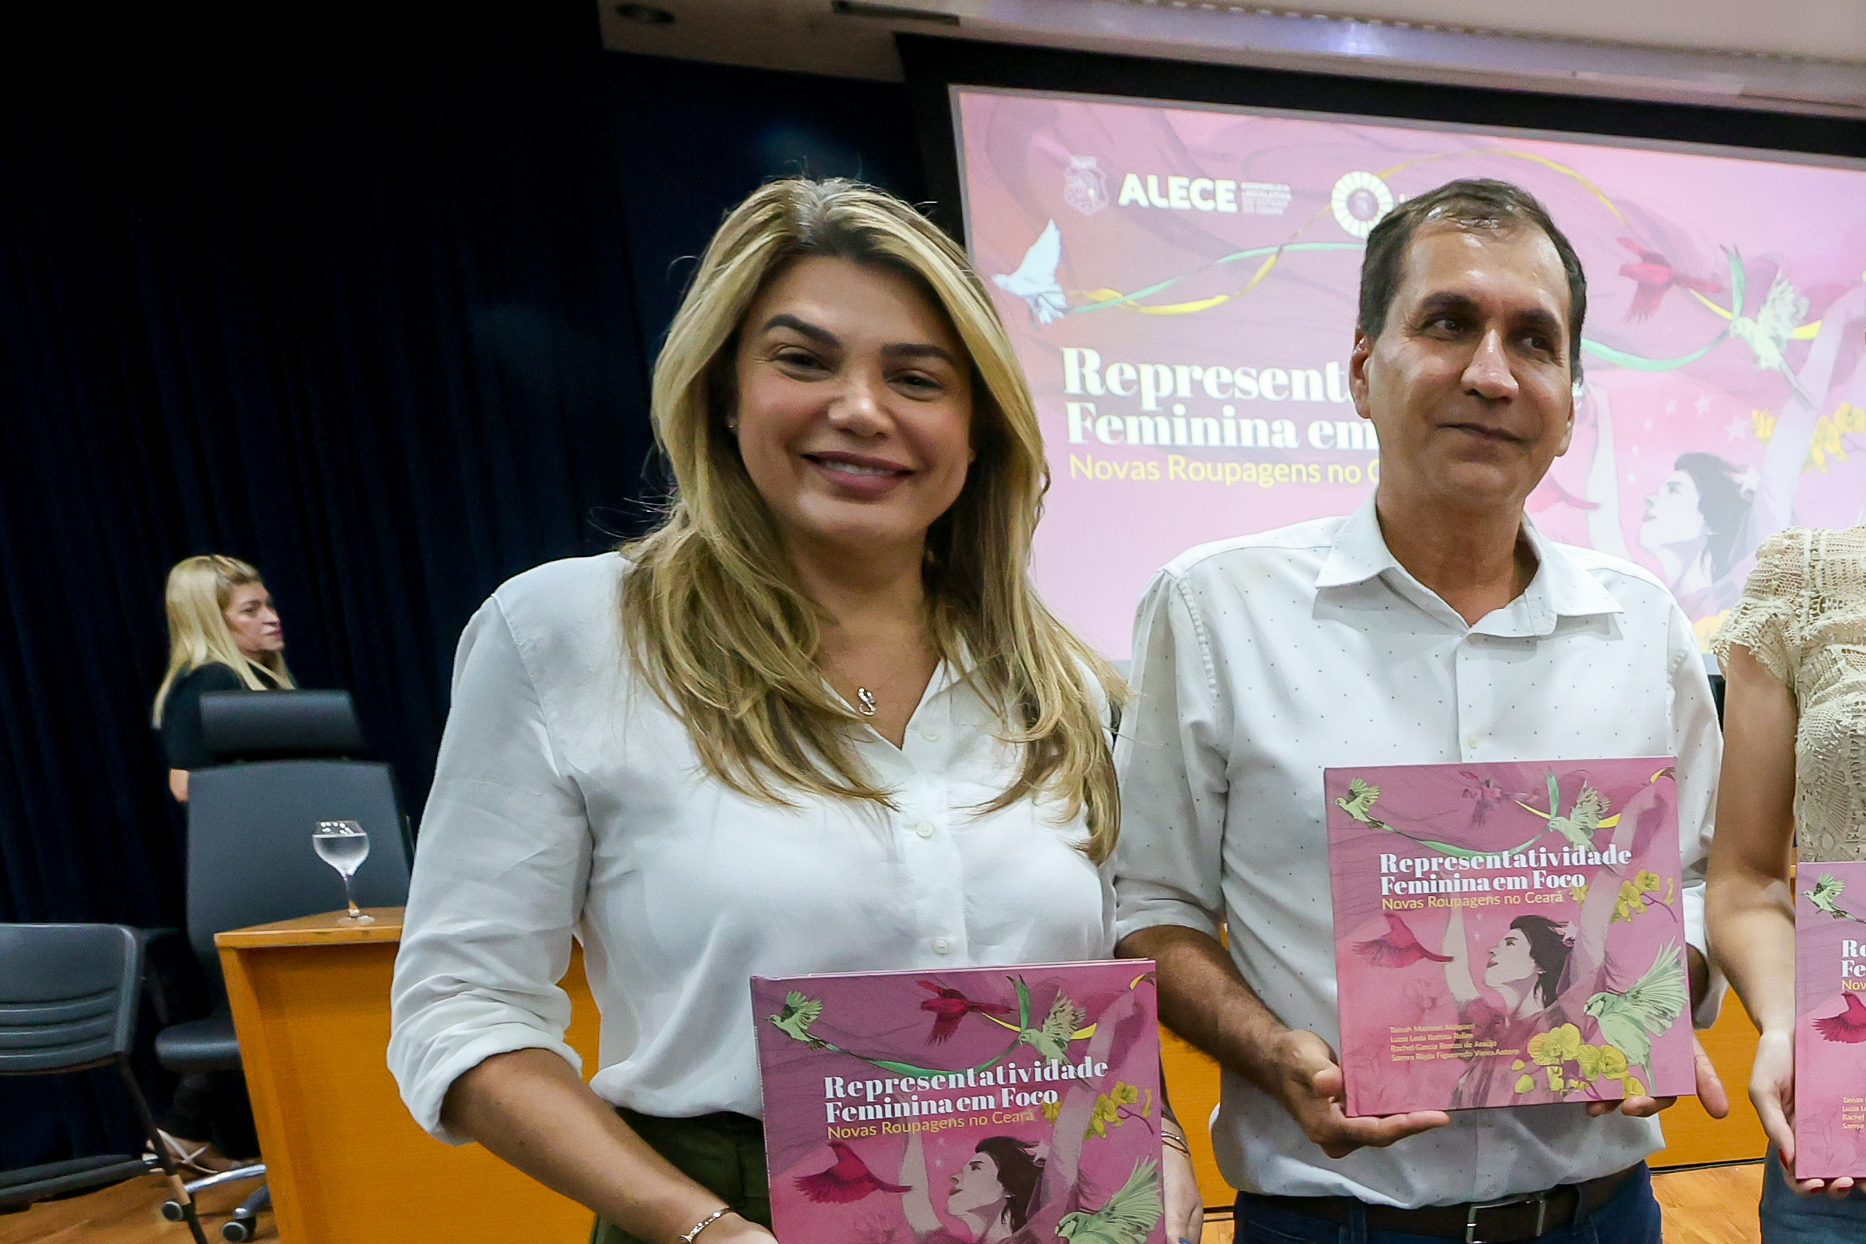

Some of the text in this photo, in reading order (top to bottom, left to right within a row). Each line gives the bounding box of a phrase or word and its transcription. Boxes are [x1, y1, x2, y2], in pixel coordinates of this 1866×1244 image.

[1118, 173, 1239, 213] ALECE
[1061, 346, 1353, 411] Represent
[1066, 401, 1380, 451] Feminina em
[1069, 453, 1161, 481] Novas
[1168, 454, 1322, 488] Roupagens
[1328, 463, 1362, 484] no
[1379, 844, 1632, 877] Representatividade
[1380, 870, 1586, 895] Feminina em Foco
[1382, 890, 1563, 910] Novas Roupagens no Ceará
[824, 1055, 1108, 1102] Representatividade
[825, 1087, 1059, 1124] Feminina em Foco
[827, 1110, 1035, 1139] Novas Roupagens no Ceará
